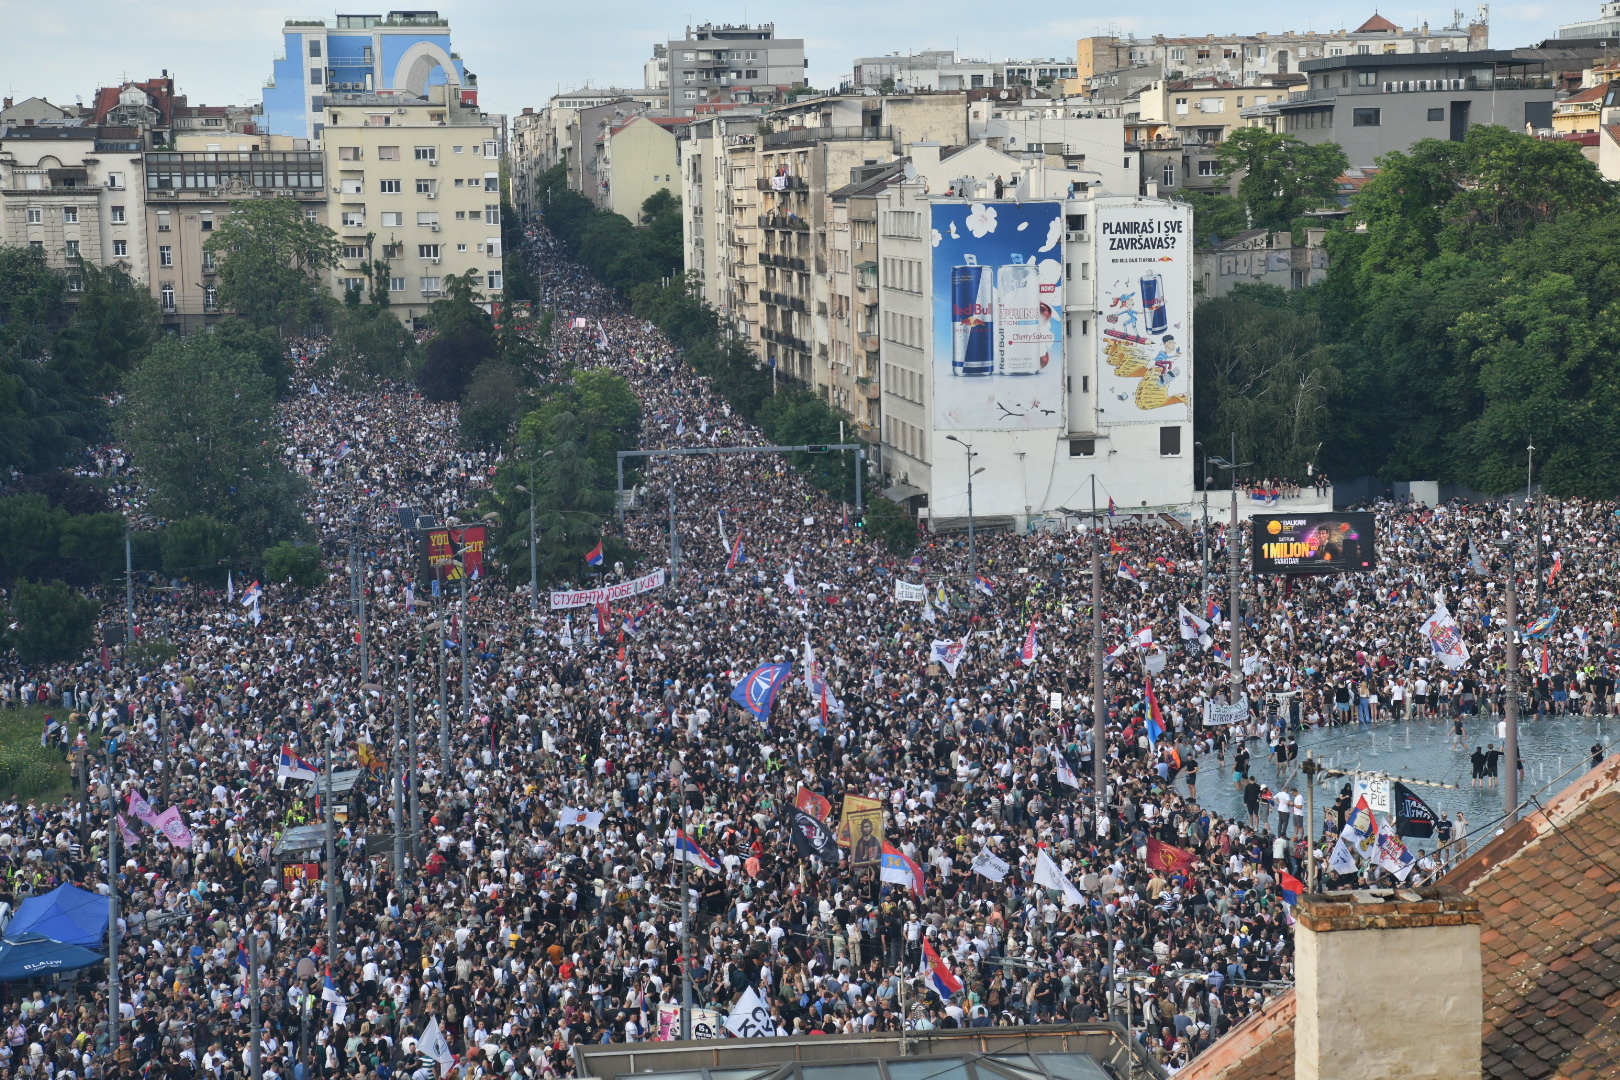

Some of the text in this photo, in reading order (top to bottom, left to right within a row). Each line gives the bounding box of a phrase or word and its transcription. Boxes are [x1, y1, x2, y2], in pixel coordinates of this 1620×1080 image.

[1102, 218, 1182, 234] PLANIRAŠ I SVE
[1109, 234, 1176, 250] ZAVRŠAVAŠ?
[953, 303, 991, 315] Red Bull
[1012, 333, 1032, 341] Cherry
[1262, 543, 1268, 559] 1
[1270, 542, 1310, 558] MILION
[553, 574, 660, 605] СТУДЕНТИ ПОБЕУЈУ!
[24, 960, 62, 969] BLAUW
